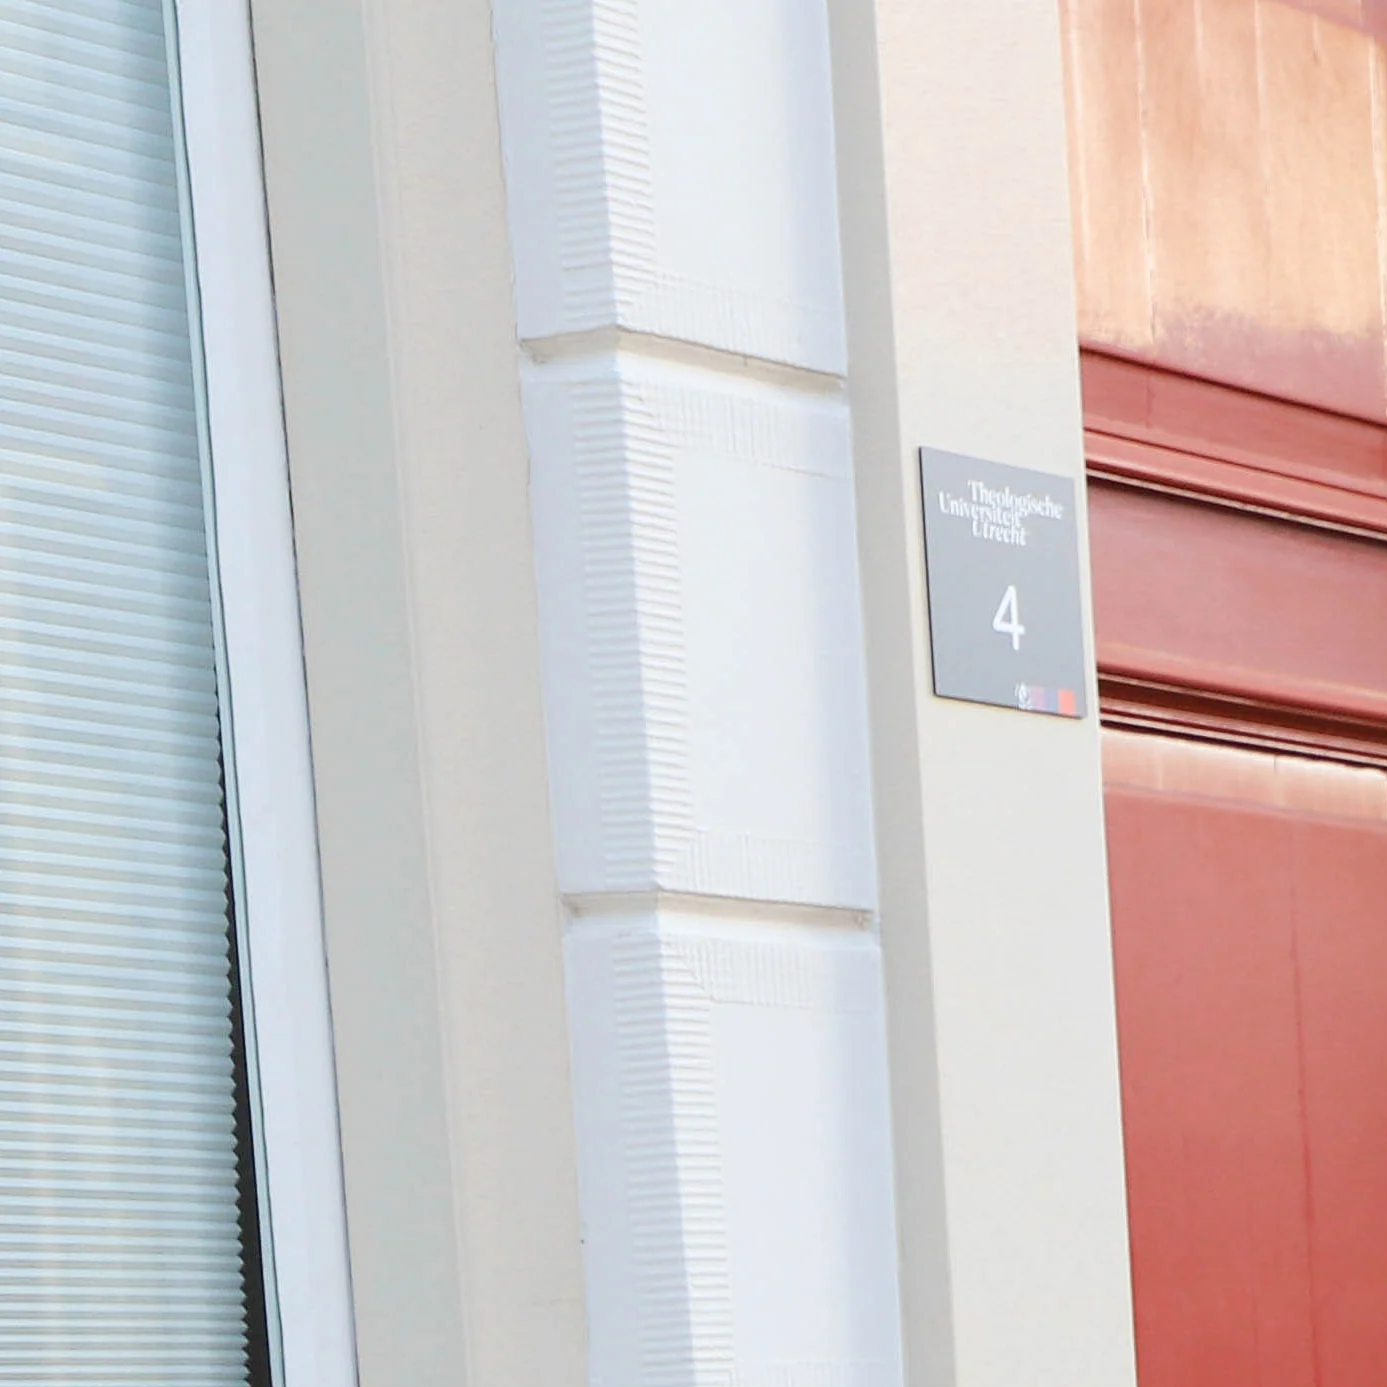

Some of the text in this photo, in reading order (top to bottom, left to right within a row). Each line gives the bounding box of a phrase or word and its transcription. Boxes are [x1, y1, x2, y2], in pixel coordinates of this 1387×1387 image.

[938, 488, 1022, 527] Universiteit
[967, 479, 1064, 520] Theologische
[971, 519, 1028, 547] Utrecht
[992, 584, 1026, 651] 4
